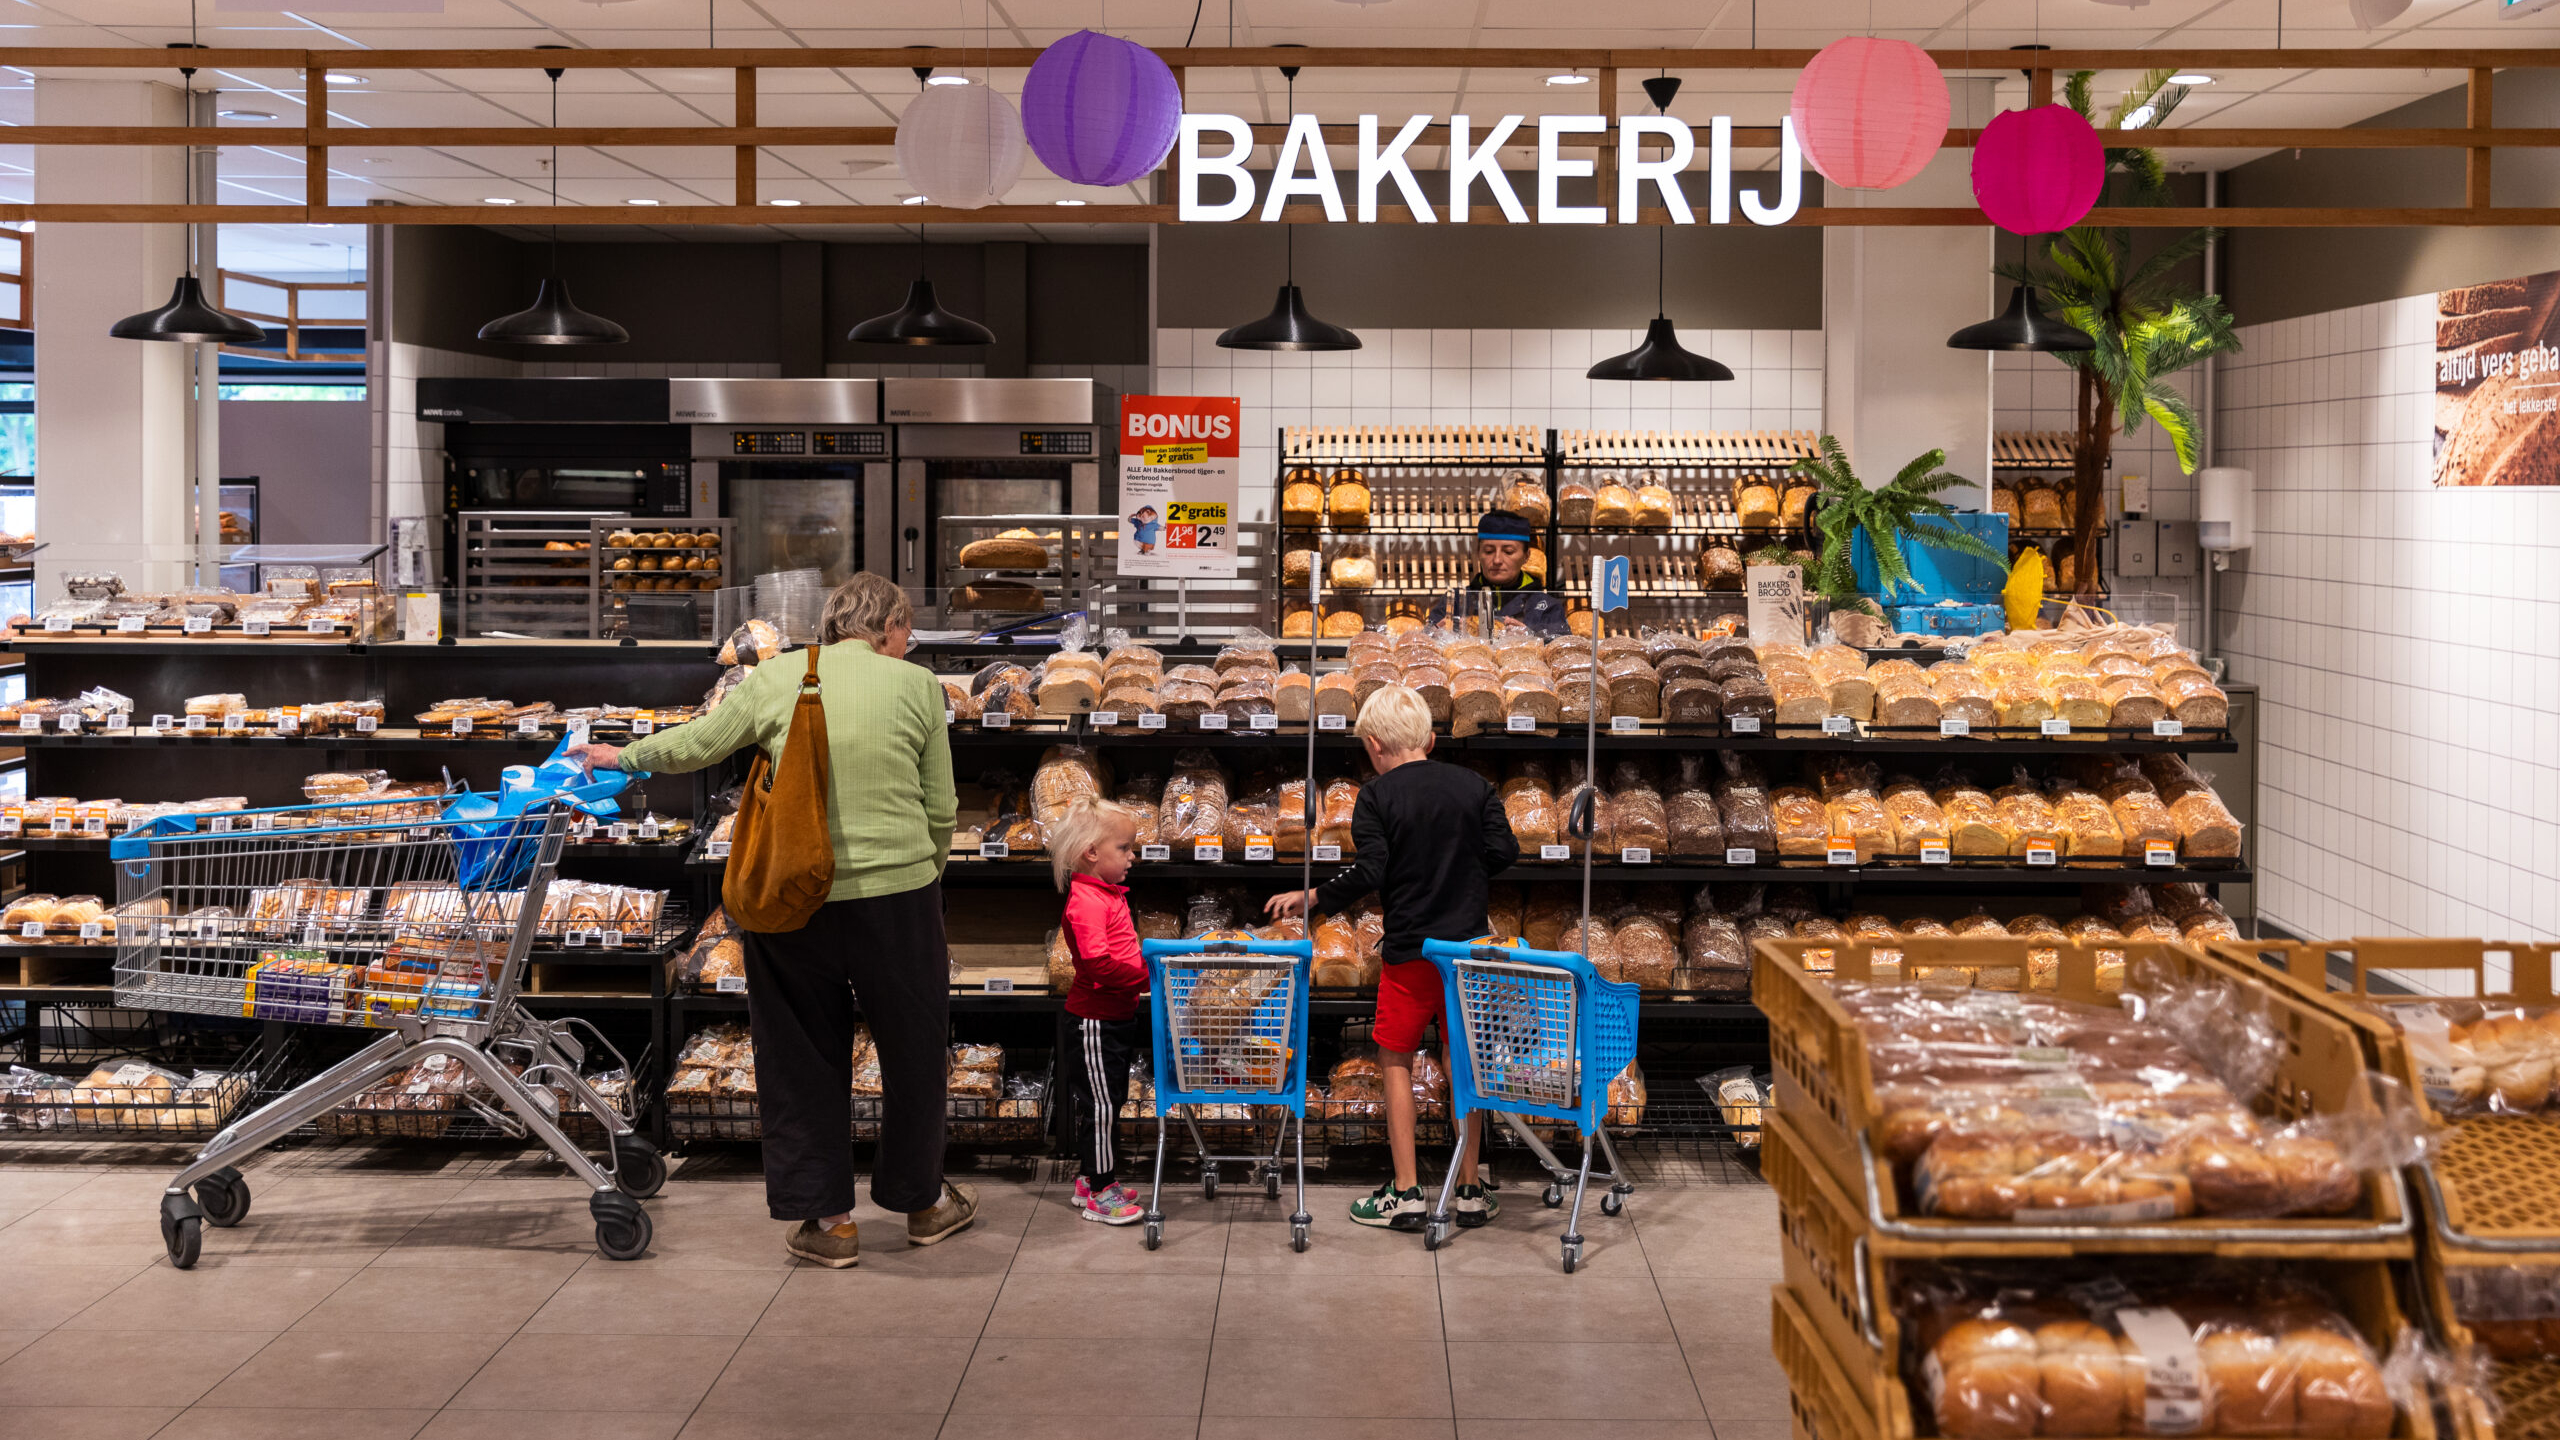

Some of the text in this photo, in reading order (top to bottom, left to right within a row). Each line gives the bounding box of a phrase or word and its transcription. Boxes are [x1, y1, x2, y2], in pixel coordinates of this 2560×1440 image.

[1179, 113, 1802, 226] BAKKERIJ
[2440, 350, 2475, 386] altijd
[2481, 350, 2514, 377] vers
[2504, 397, 2557, 414] het lekkerste
[1128, 413, 1232, 439] BONUS
[1168, 453, 1194, 463] gratis
[1168, 502, 1227, 521] 2e gratis
[1758, 588, 1791, 597] BROOD
[2031, 839, 2052, 847] BONUS
